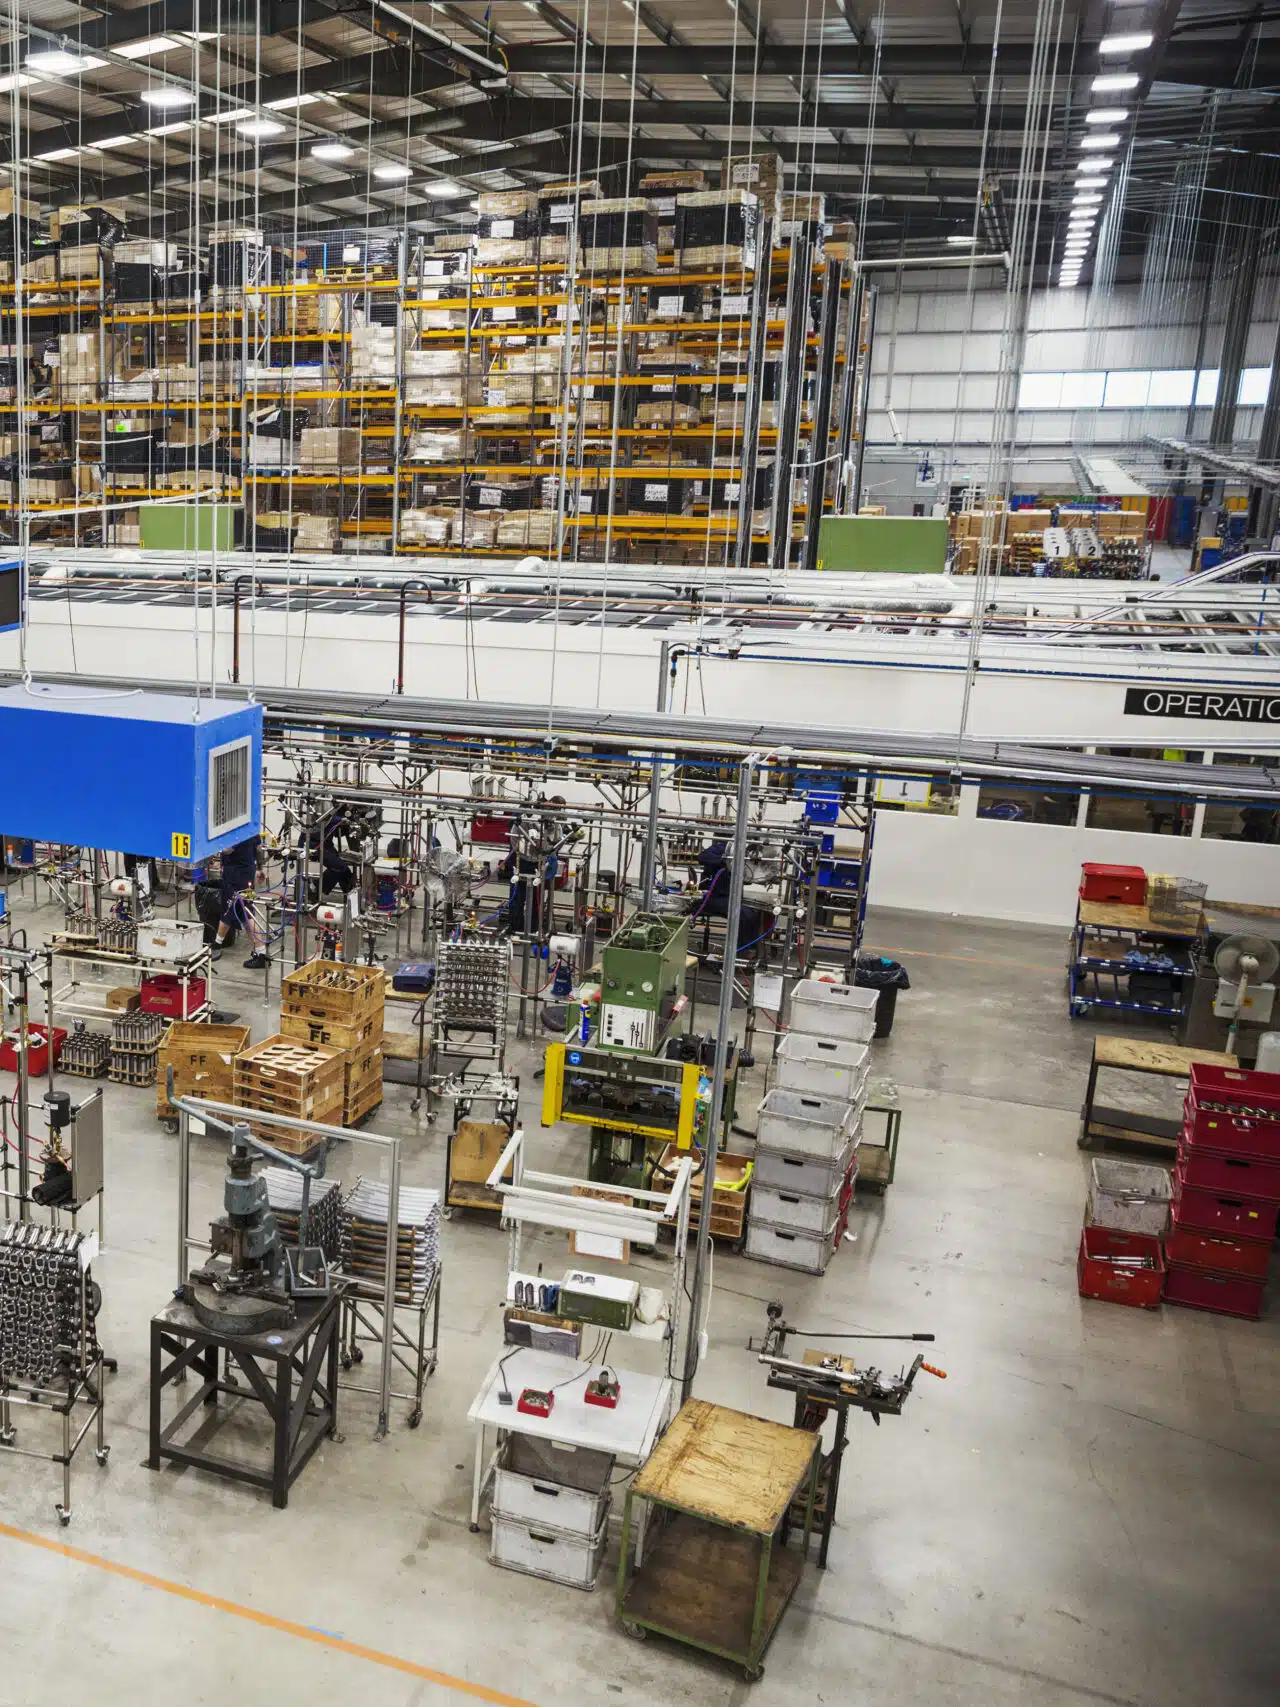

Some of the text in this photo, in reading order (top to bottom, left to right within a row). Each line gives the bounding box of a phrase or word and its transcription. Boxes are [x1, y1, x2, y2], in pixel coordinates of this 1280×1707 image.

[1054, 546, 1060, 555] 1
[1087, 546, 1096, 556] 2
[1143, 692, 1280, 720] OPERATIO
[175, 836, 189, 856] 15
[288, 983, 308, 998] FF
[365, 982, 375, 999] FF
[289, 1004, 301, 1013] FF
[309, 1028, 332, 1044] FF
[363, 1021, 373, 1039] FF
[190, 1055, 206, 1065] FF
[362, 1056, 372, 1073] FF
